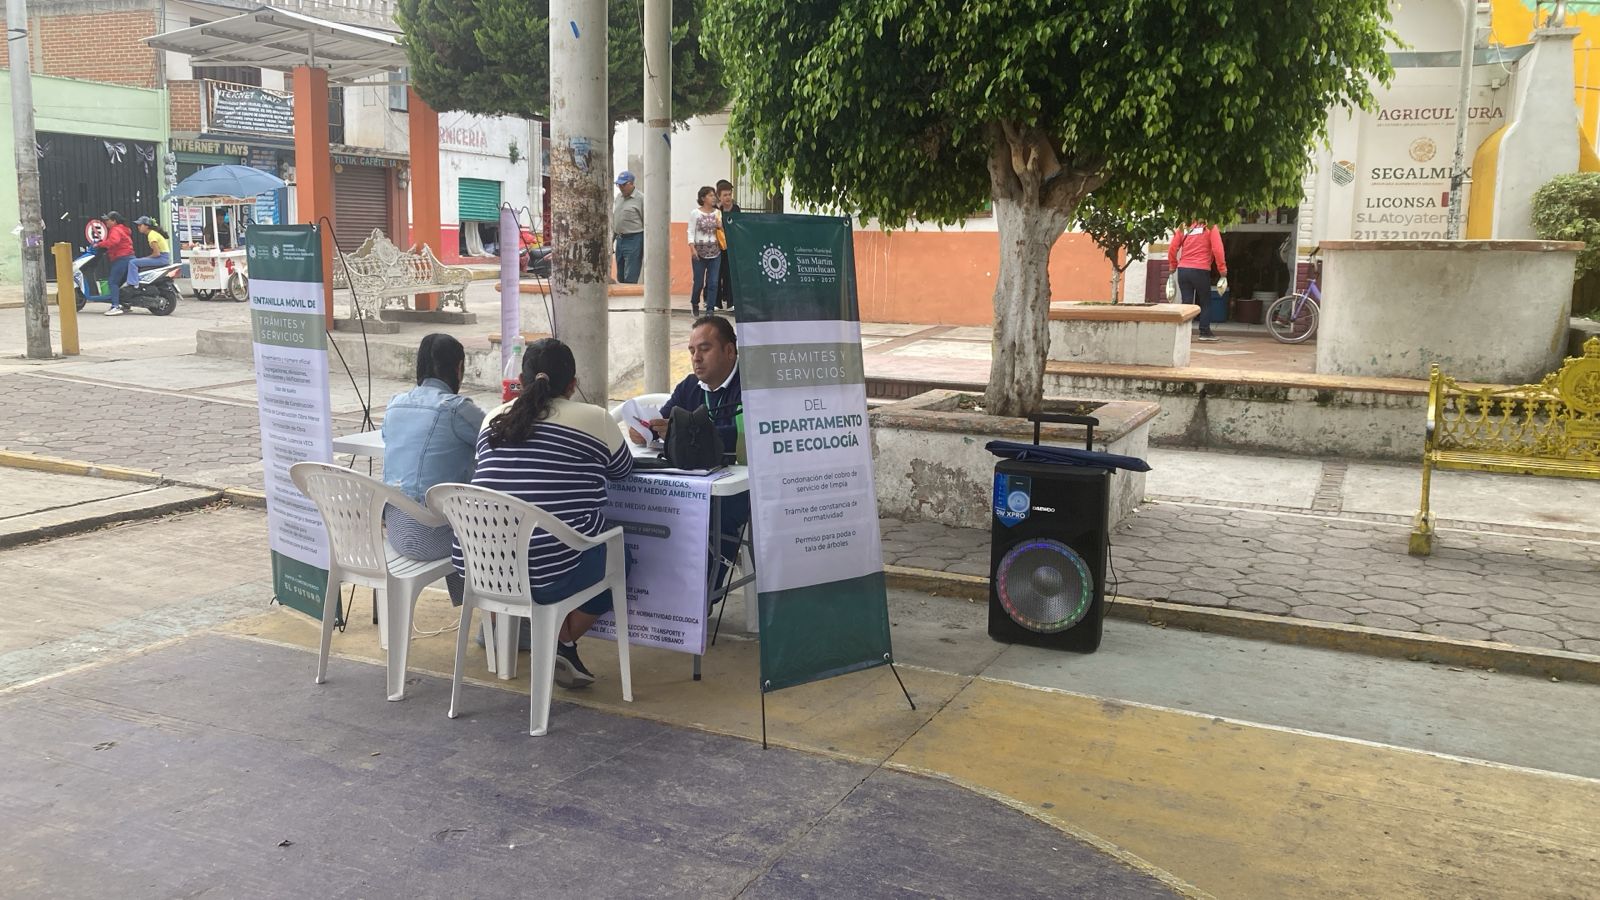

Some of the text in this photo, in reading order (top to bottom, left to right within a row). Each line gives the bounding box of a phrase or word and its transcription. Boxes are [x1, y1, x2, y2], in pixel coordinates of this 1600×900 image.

[1377, 107, 1504, 121] AGRICULURA
[438, 126, 488, 148] RNICERIA
[172, 140, 249, 156] INTERNET NAYS
[1366, 197, 1437, 209] LICONSA
[1356, 212, 1468, 227] S.L.Atoyateno
[796, 256, 810, 265] San
[796, 264, 836, 274] Texmelucan
[252, 296, 285, 307] ENTANILLA
[300, 320, 306, 330] Y
[261, 330, 305, 343] SERVICIOS
[771, 349, 846, 364] TRÁMITES Y
[777, 366, 846, 381] SERVICIOS
[804, 399, 827, 412] DEL
[758, 414, 863, 435] DEPARTAMENTO
[772, 431, 859, 454] DE ECOLOGÍA
[823, 472, 833, 480] del
[834, 471, 851, 479] cobro
[644, 487, 667, 496] MEDIO
[668, 490, 707, 500] AMBIENTE
[796, 484, 820, 493] servicio
[624, 502, 646, 511] MEDIO
[647, 504, 681, 515] AMBIENTE
[810, 505, 818, 513] de
[819, 501, 851, 511] constancia
[803, 511, 844, 523] normatividad
[1006, 511, 1026, 519] XPRO
[795, 535, 821, 544] Permiso
[822, 533, 836, 541] para
[636, 609, 672, 621] NORMATIVIDAD
[651, 627, 682, 637] TRANSPORTE
[661, 635, 685, 645] URBANOS
